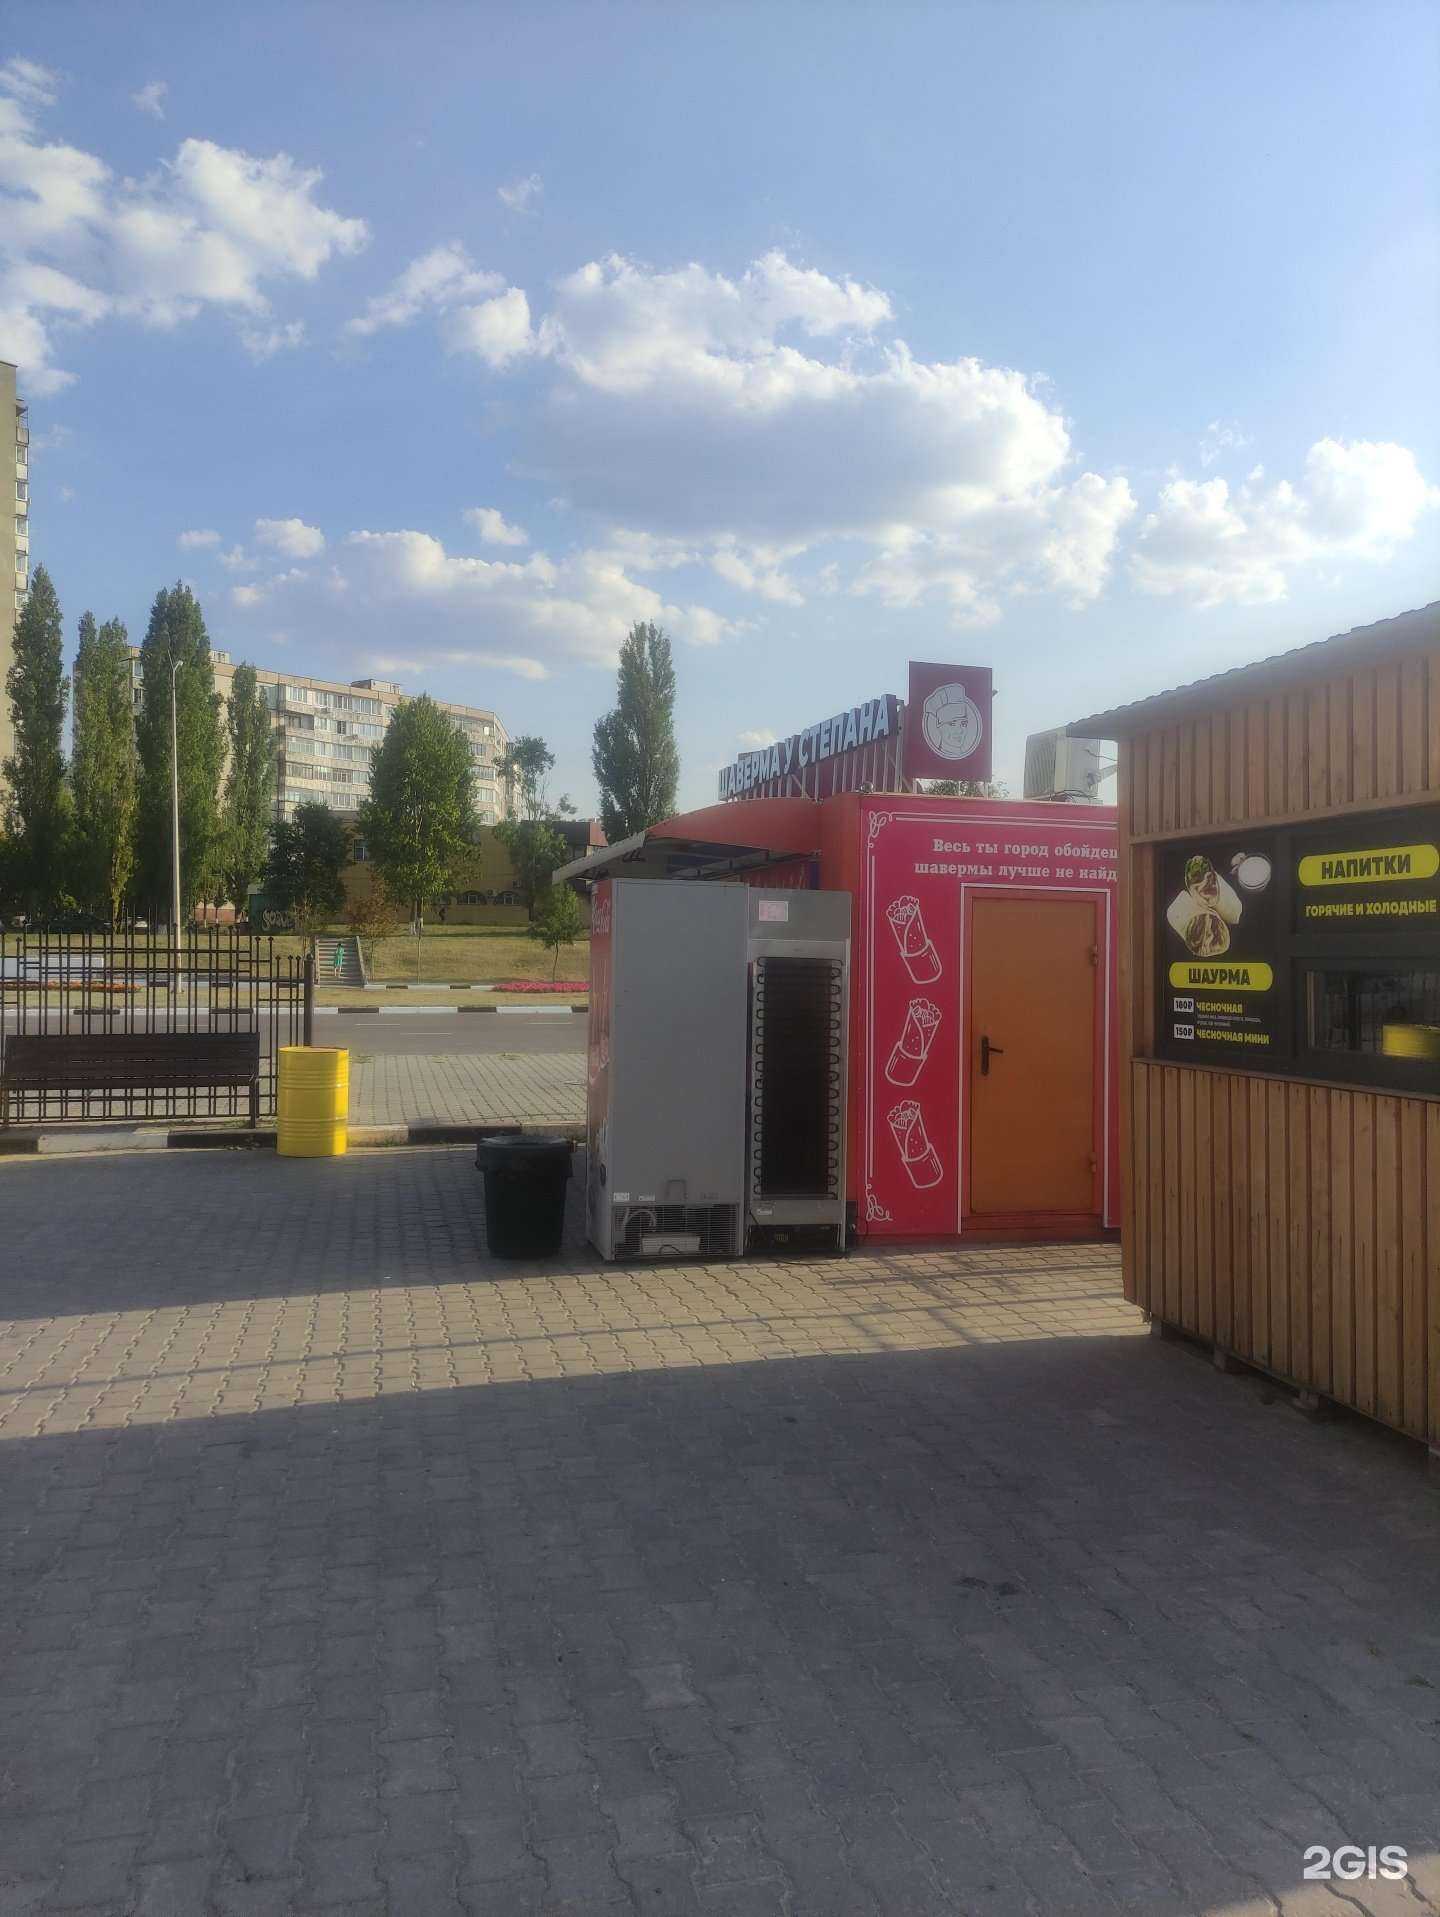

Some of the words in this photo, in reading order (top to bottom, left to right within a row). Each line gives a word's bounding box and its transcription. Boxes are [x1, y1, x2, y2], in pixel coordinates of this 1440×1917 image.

[783, 735, 796, 775] У
[799, 694, 890, 768] СТЕПАНА
[933, 838, 971, 853] Весь
[975, 843, 998, 855] ты
[1004, 844, 1049, 858] город
[914, 863, 993, 878] шавермы
[998, 865, 1050, 880] лучше
[1055, 867, 1073, 879] не
[1321, 854, 1411, 880] НАПИТКИ
[1305, 903, 1353, 917] ГОРЯЧИЕ
[1355, 903, 1364, 916] И
[1365, 899, 1437, 916] ХОЛОДНЫЕ
[1188, 967, 1251, 986] ШАУРМА
[1196, 1001, 1243, 1014] ЧЕСНОЧНАЯ
[1196, 1028, 1243, 1042] ЧЕСНОЧНАЯ
[1244, 1033, 1270, 1045] МИНИ
